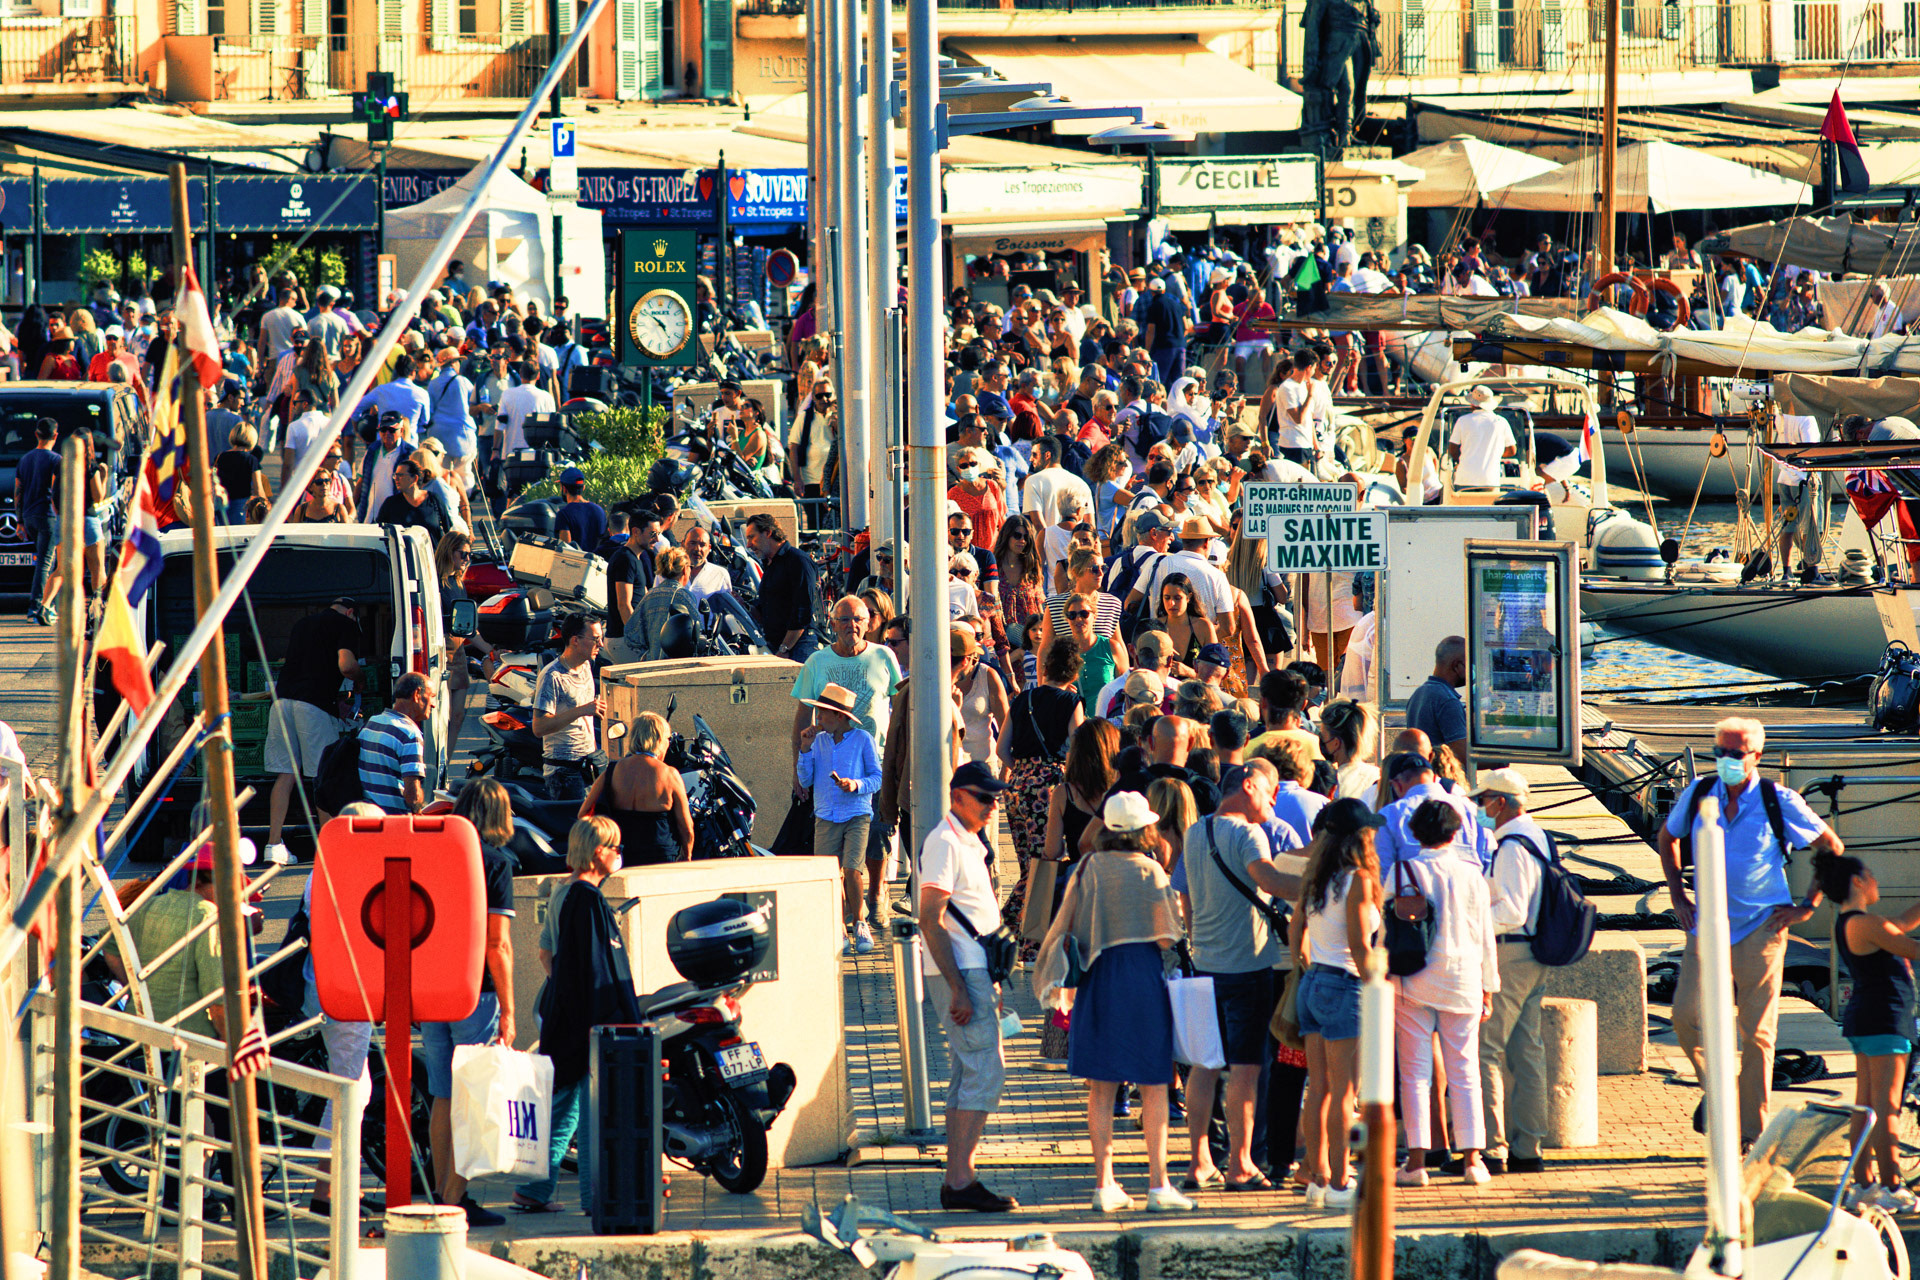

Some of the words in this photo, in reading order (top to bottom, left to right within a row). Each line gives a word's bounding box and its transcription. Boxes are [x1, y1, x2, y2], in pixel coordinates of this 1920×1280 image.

[557, 127, 570, 152] P
[1196, 169, 1280, 190] CECILE
[617, 181, 630, 199] DE
[1003, 181, 1021, 194] Les
[758, 205, 794, 220] Tropez
[995, 237, 1065, 251] Boissons
[634, 261, 687, 273] ROLEX
[1249, 487, 1353, 502] PORT-GRIMAUD
[1249, 503, 1264, 517] LES
[1265, 503, 1302, 514] MARINES
[1303, 504, 1314, 513] DE
[1248, 519, 1259, 533] LA
[1284, 517, 1372, 542] SAINTE
[1277, 543, 1380, 568] MAXIME
[723, 921, 748, 932] SHAD
[723, 1057, 763, 1076] 677-LP
